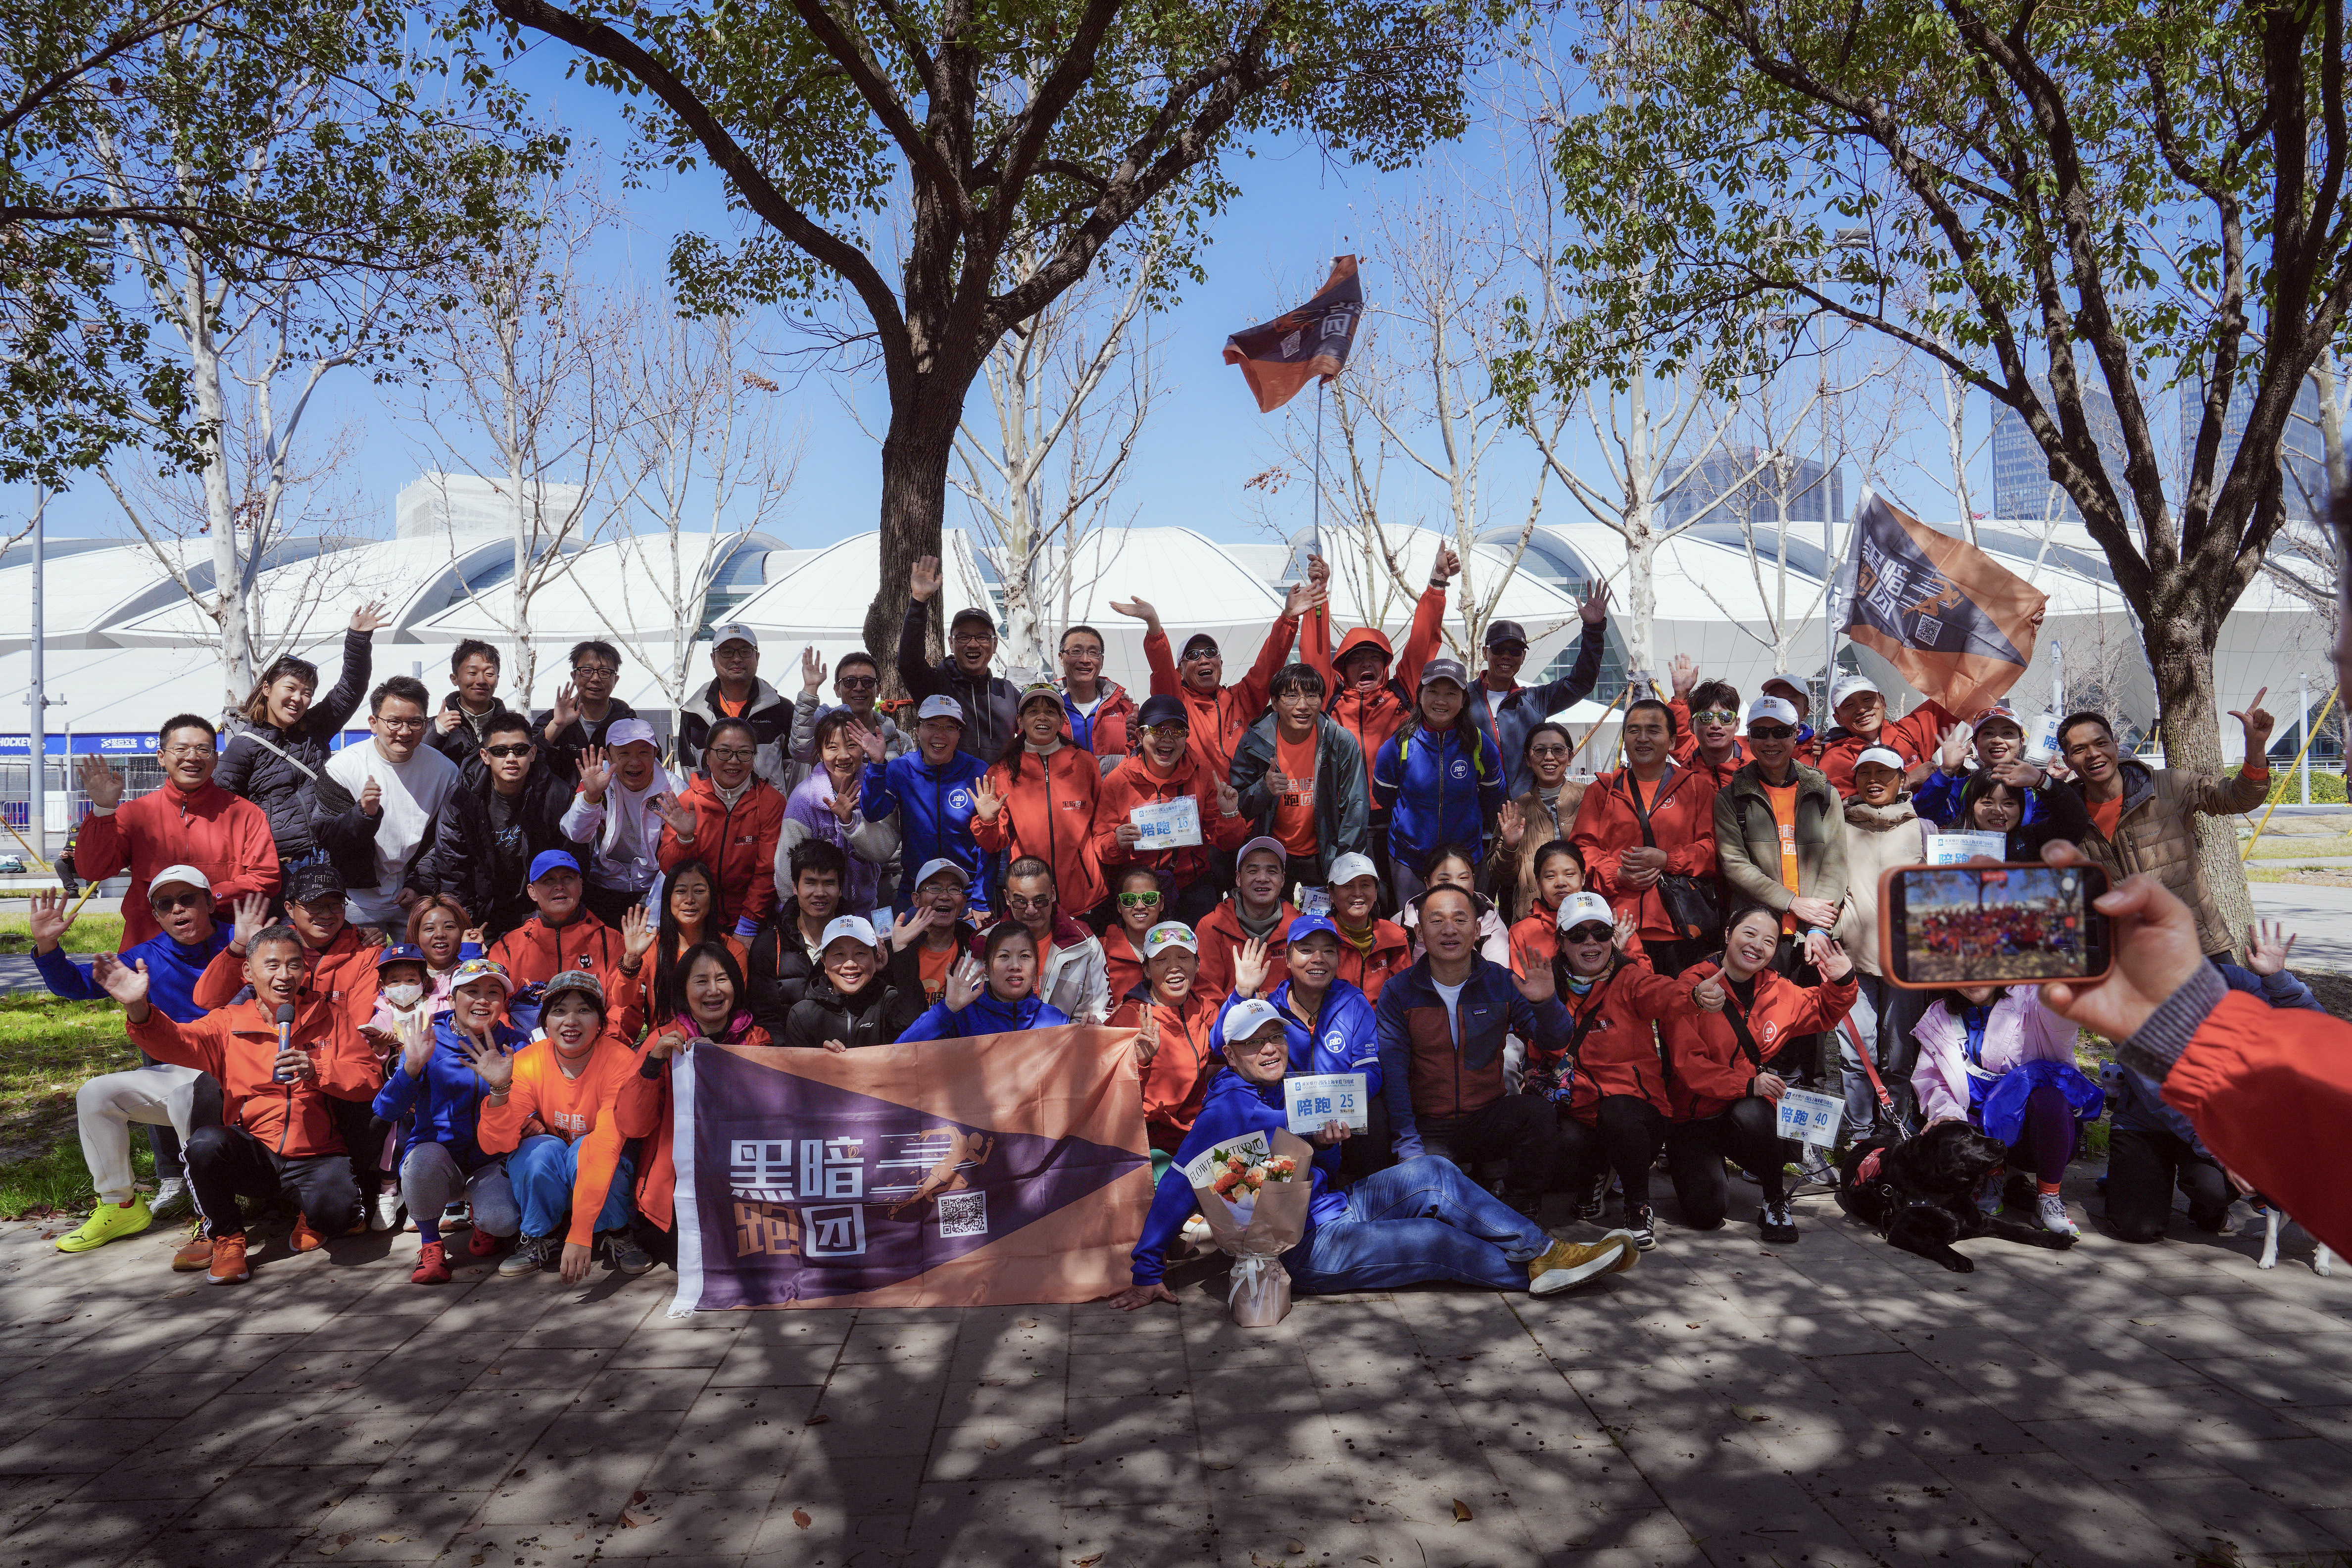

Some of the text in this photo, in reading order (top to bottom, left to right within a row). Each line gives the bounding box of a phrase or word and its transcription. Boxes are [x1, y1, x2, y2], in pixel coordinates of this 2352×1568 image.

[1862, 535, 1911, 597] 黑暗
[1284, 792, 1313, 806] 跑团
[1141, 817, 1188, 837] 陪跑 16
[1297, 1094, 1354, 1117] 陪跑 25
[554, 1111, 586, 1131] 黑暗
[1781, 1107, 1827, 1126] 陪跑 40
[1225, 1139, 1264, 1158] STUDIO
[730, 1135, 864, 1201] 黑暗
[735, 1202, 866, 1258] 跑团
